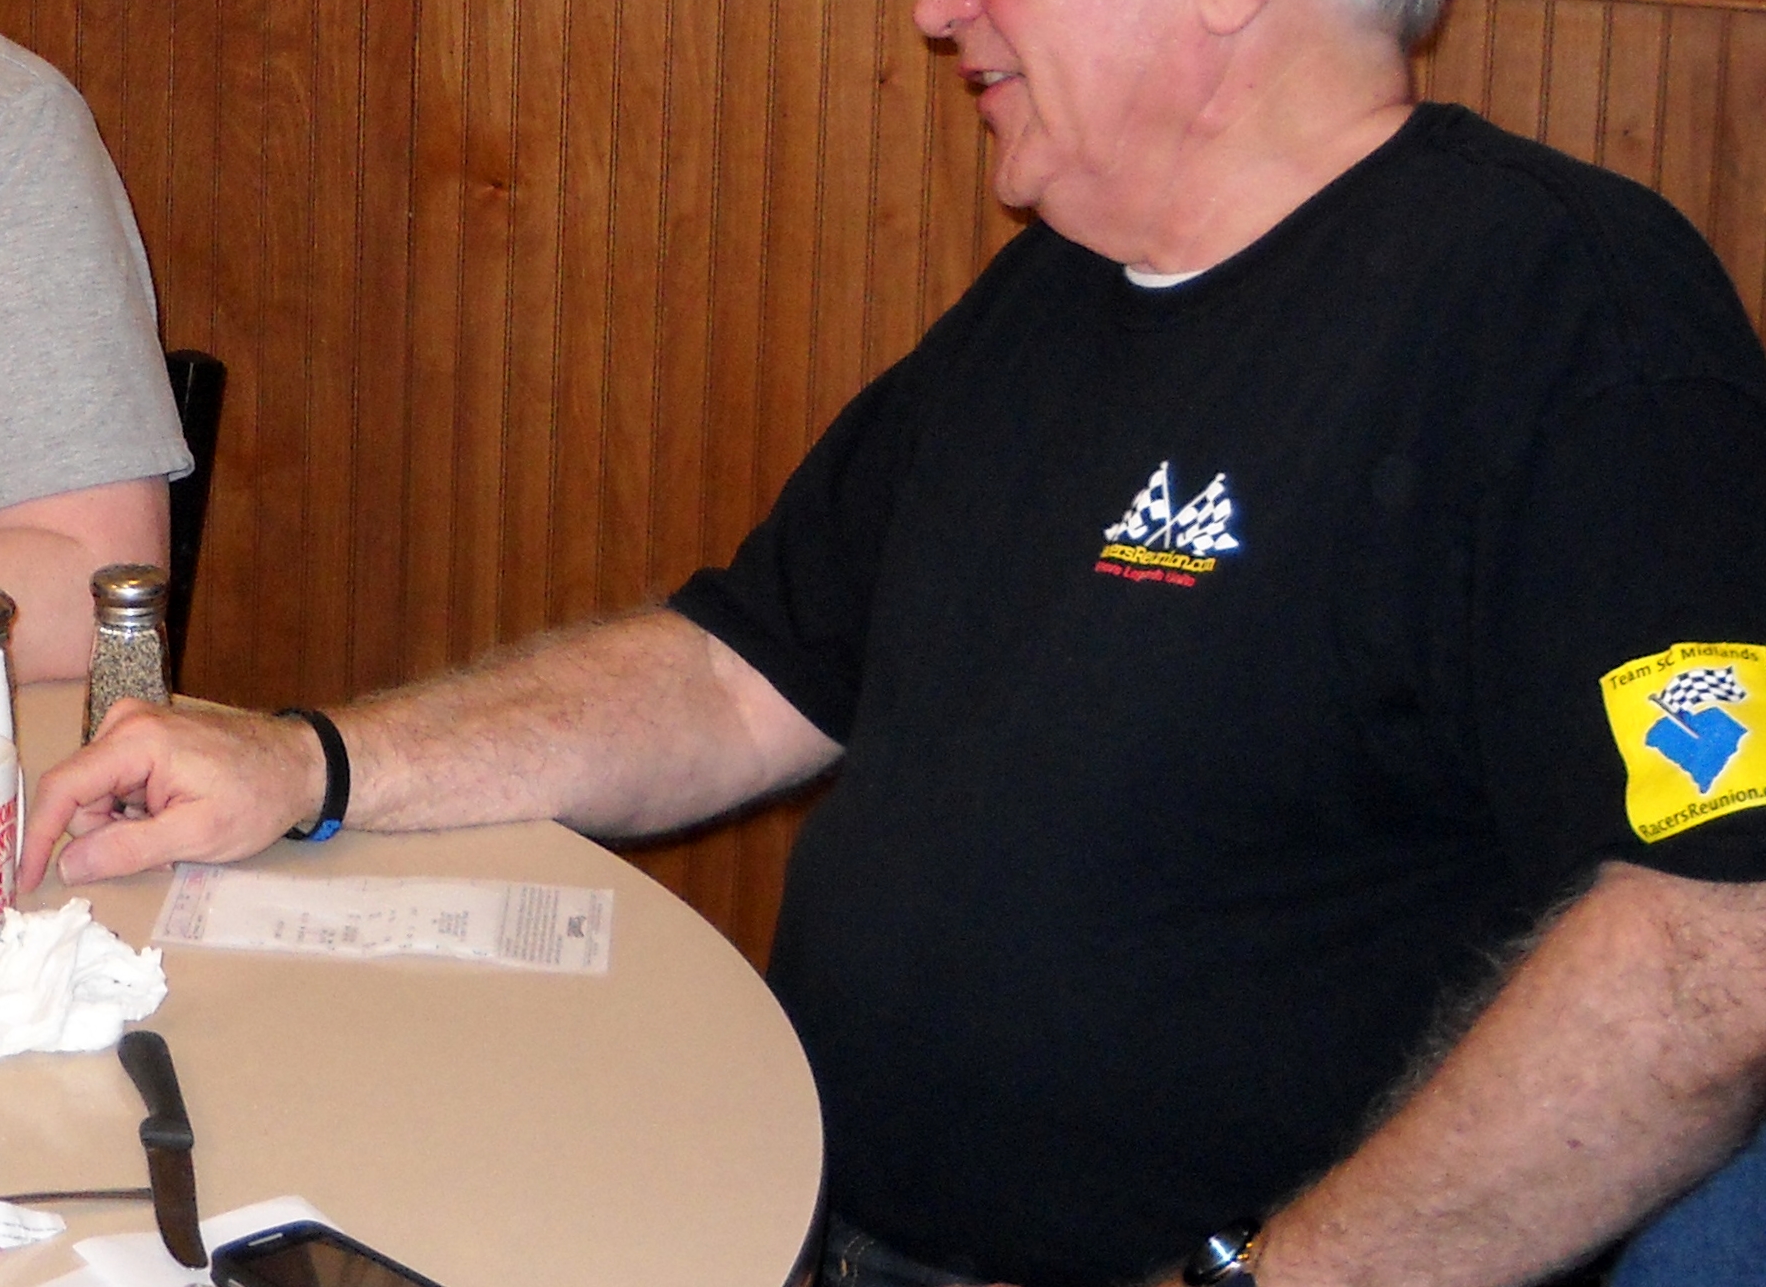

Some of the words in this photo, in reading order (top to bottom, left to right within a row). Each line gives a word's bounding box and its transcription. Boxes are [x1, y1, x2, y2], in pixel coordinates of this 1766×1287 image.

[1610, 665, 1652, 690] Team
[1657, 653, 1675, 673] SC
[1681, 645, 1759, 663] Midlands
[1638, 787, 1766, 837] RacersReunion.
